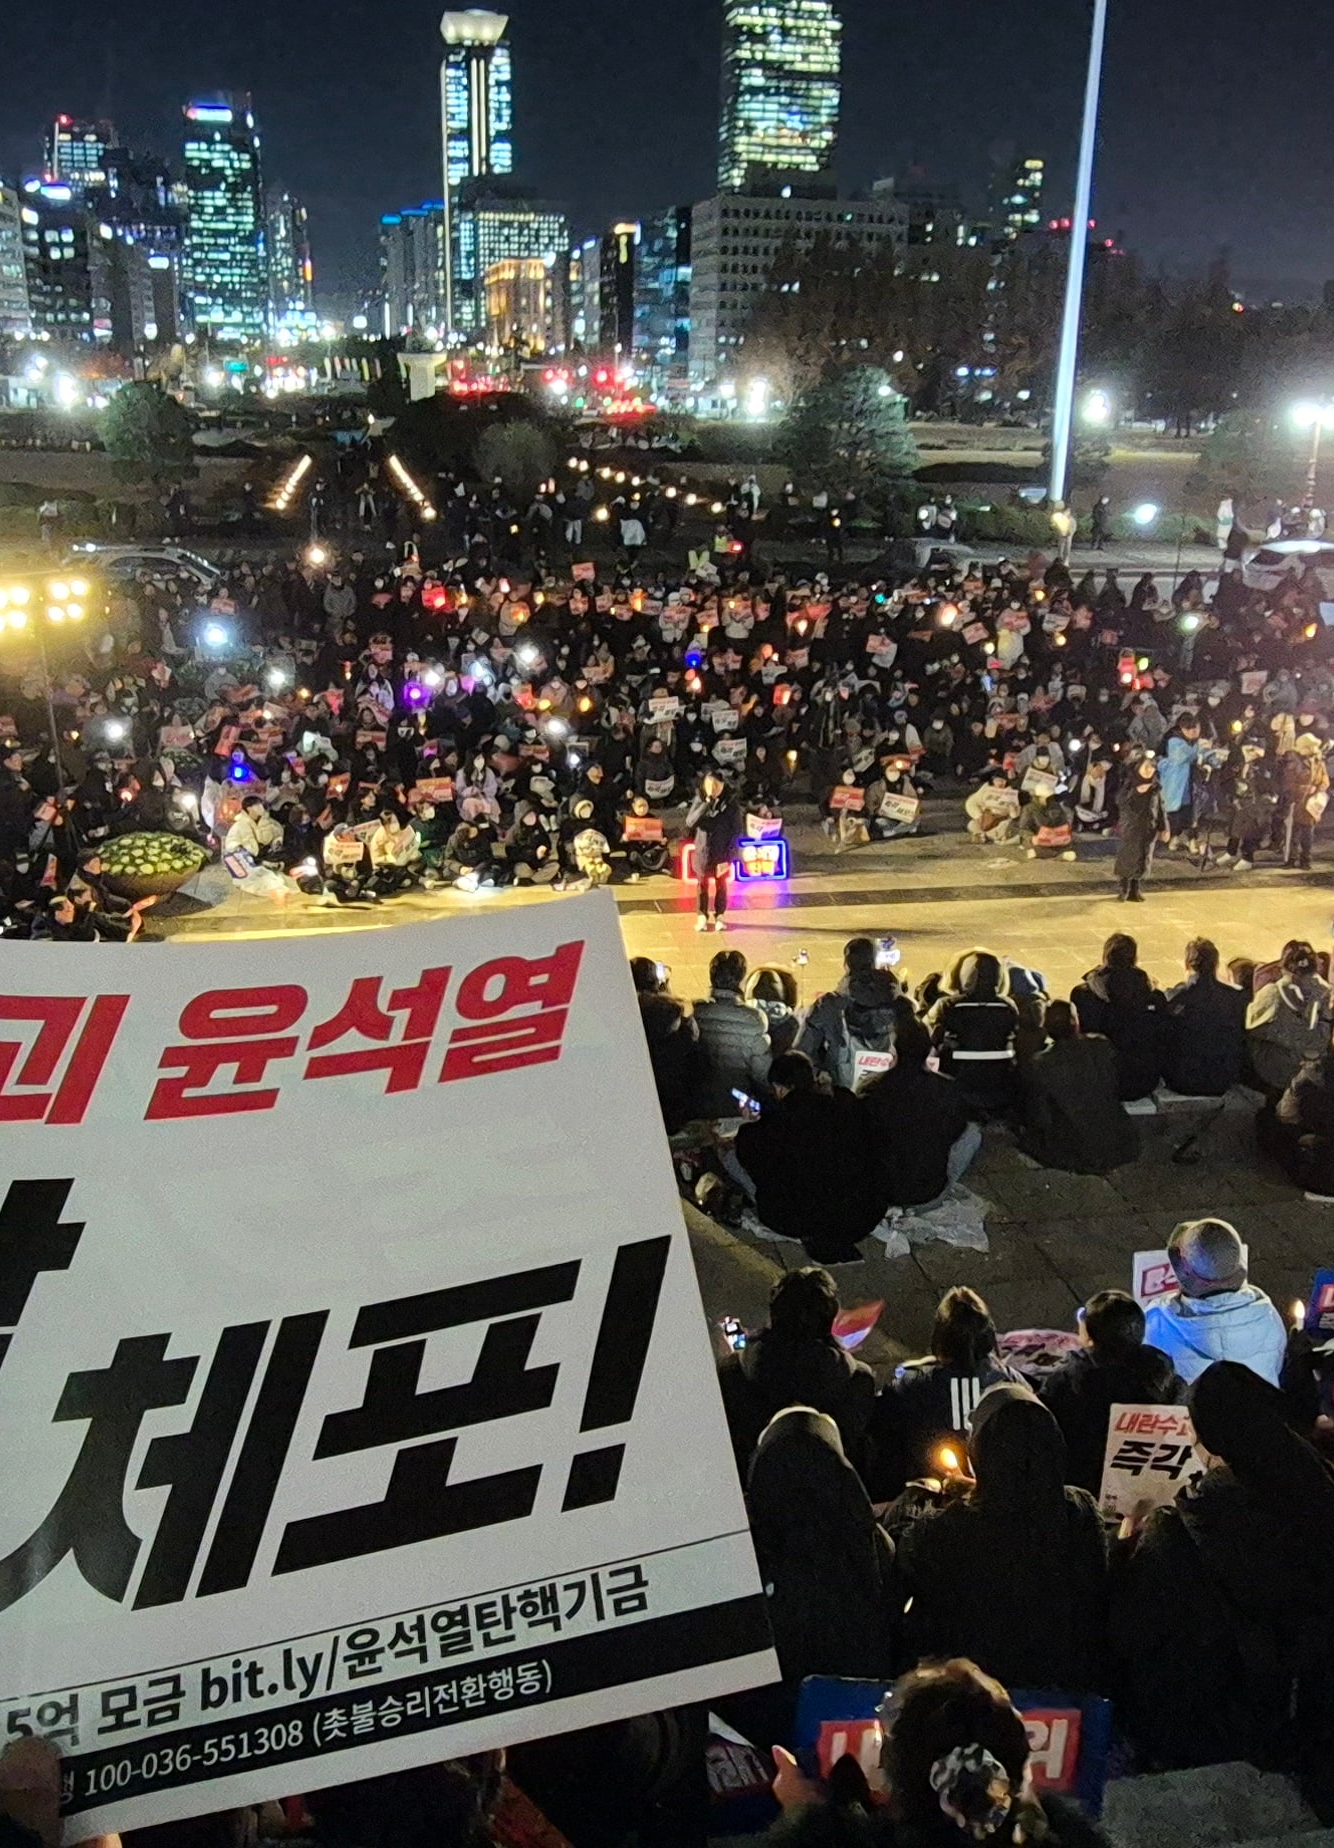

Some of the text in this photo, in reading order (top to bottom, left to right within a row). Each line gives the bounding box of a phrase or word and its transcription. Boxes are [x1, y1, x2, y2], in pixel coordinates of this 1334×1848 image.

[144, 940, 586, 1122] 윤석열
[1110, 1440, 1193, 1480] 즉각
[6, 1693, 80, 1749] 5억
[97, 1674, 187, 1736] 모금
[201, 1563, 650, 1711] bit.ly/윤석열탄핵기금
[84, 1722, 305, 1797] 100-036-551308
[312, 1659, 554, 1748] (촛불승리전환행동)
